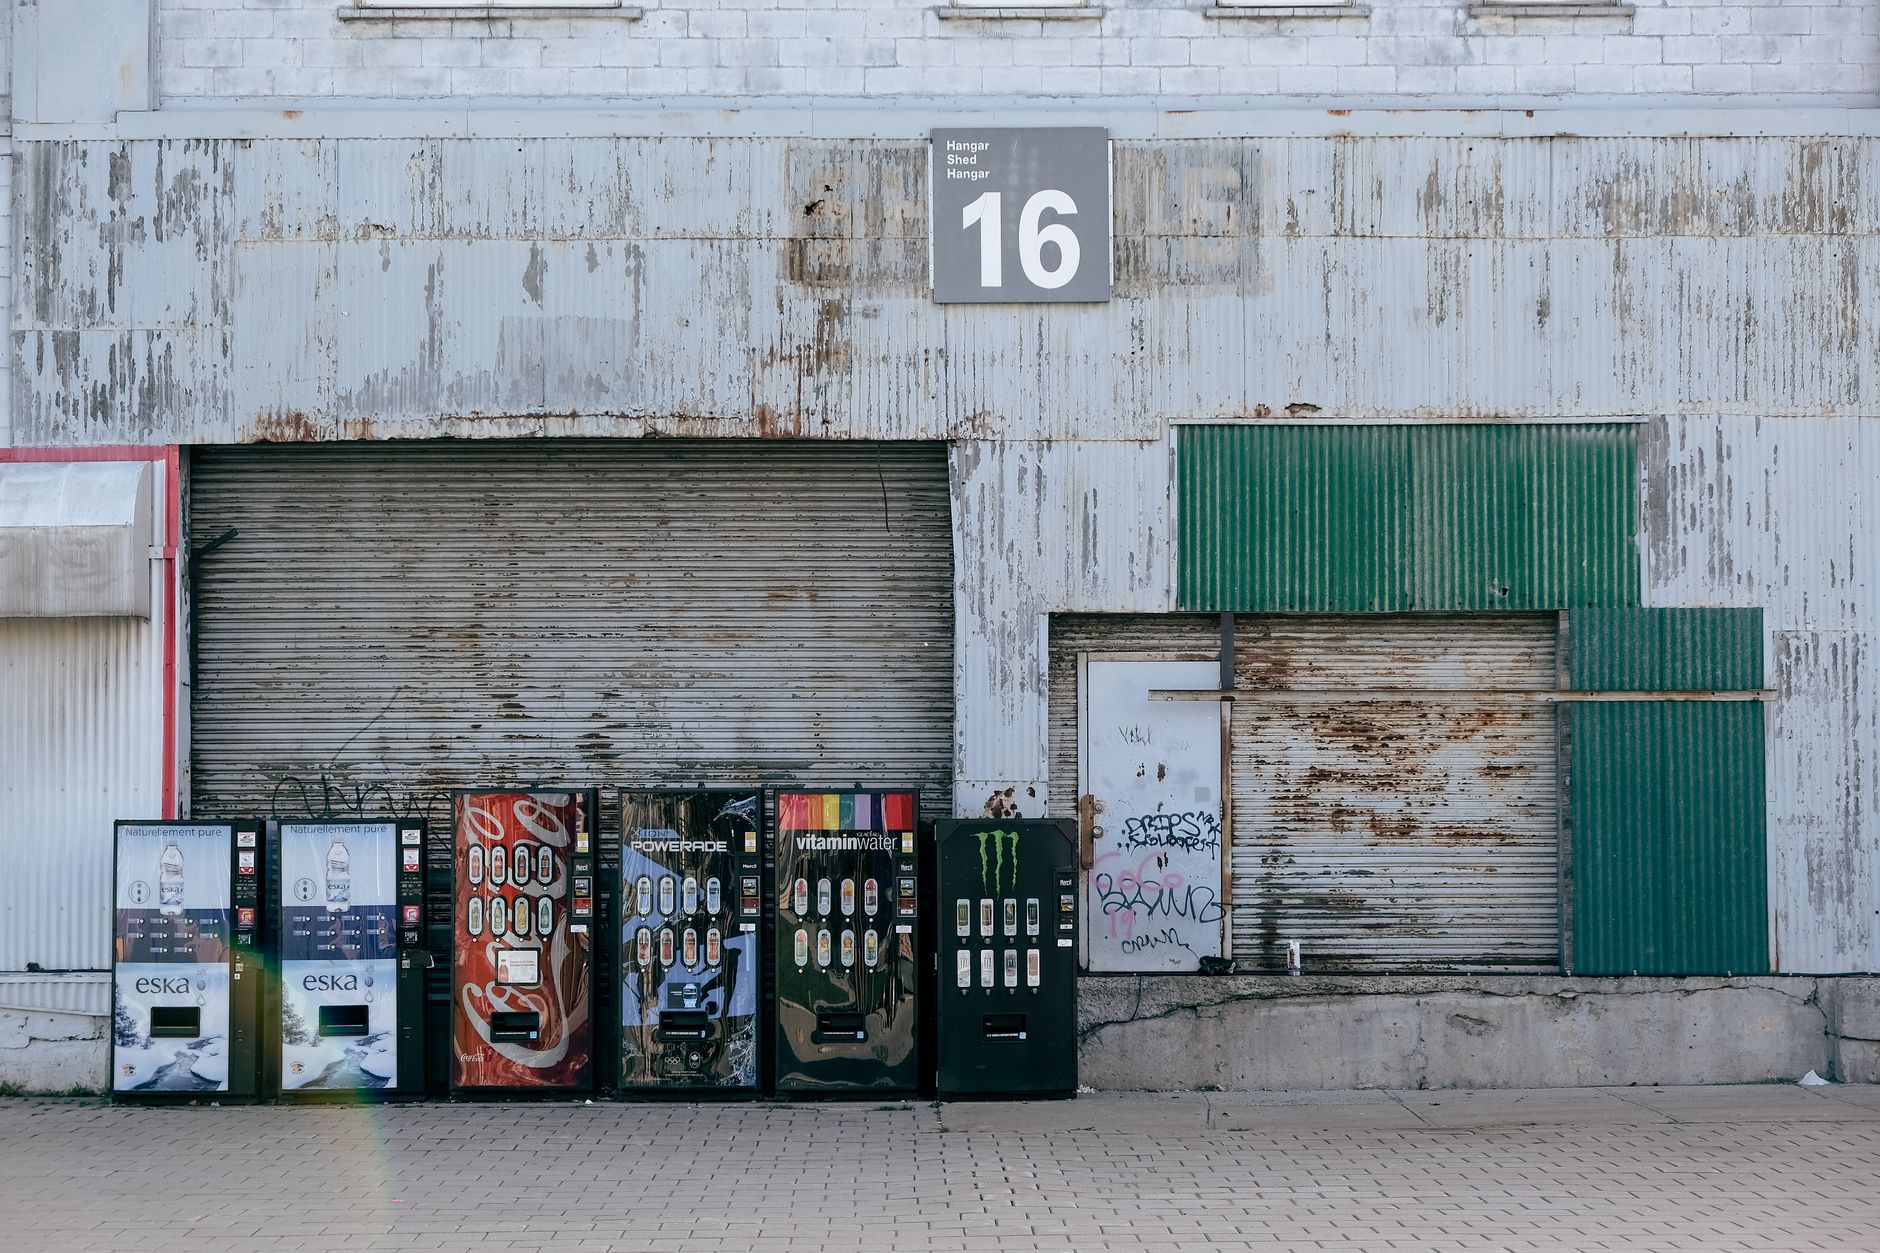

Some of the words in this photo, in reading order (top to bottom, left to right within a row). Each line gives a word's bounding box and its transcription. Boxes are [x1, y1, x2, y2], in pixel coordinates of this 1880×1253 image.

[946, 140, 990, 153] Hangar
[946, 154, 977, 165] Shed
[946, 168, 990, 180] Hangar
[962, 189, 1081, 289] 16
[125, 827, 195, 837] Naturelement
[197, 828, 222, 838] pure
[290, 825, 361, 834] Naturellement
[363, 825, 387, 835] pure
[630, 841, 728, 852] POWERADE
[796, 833, 898, 851] vitaminwater
[135, 977, 190, 994] eska
[302, 974, 358, 991] eska
